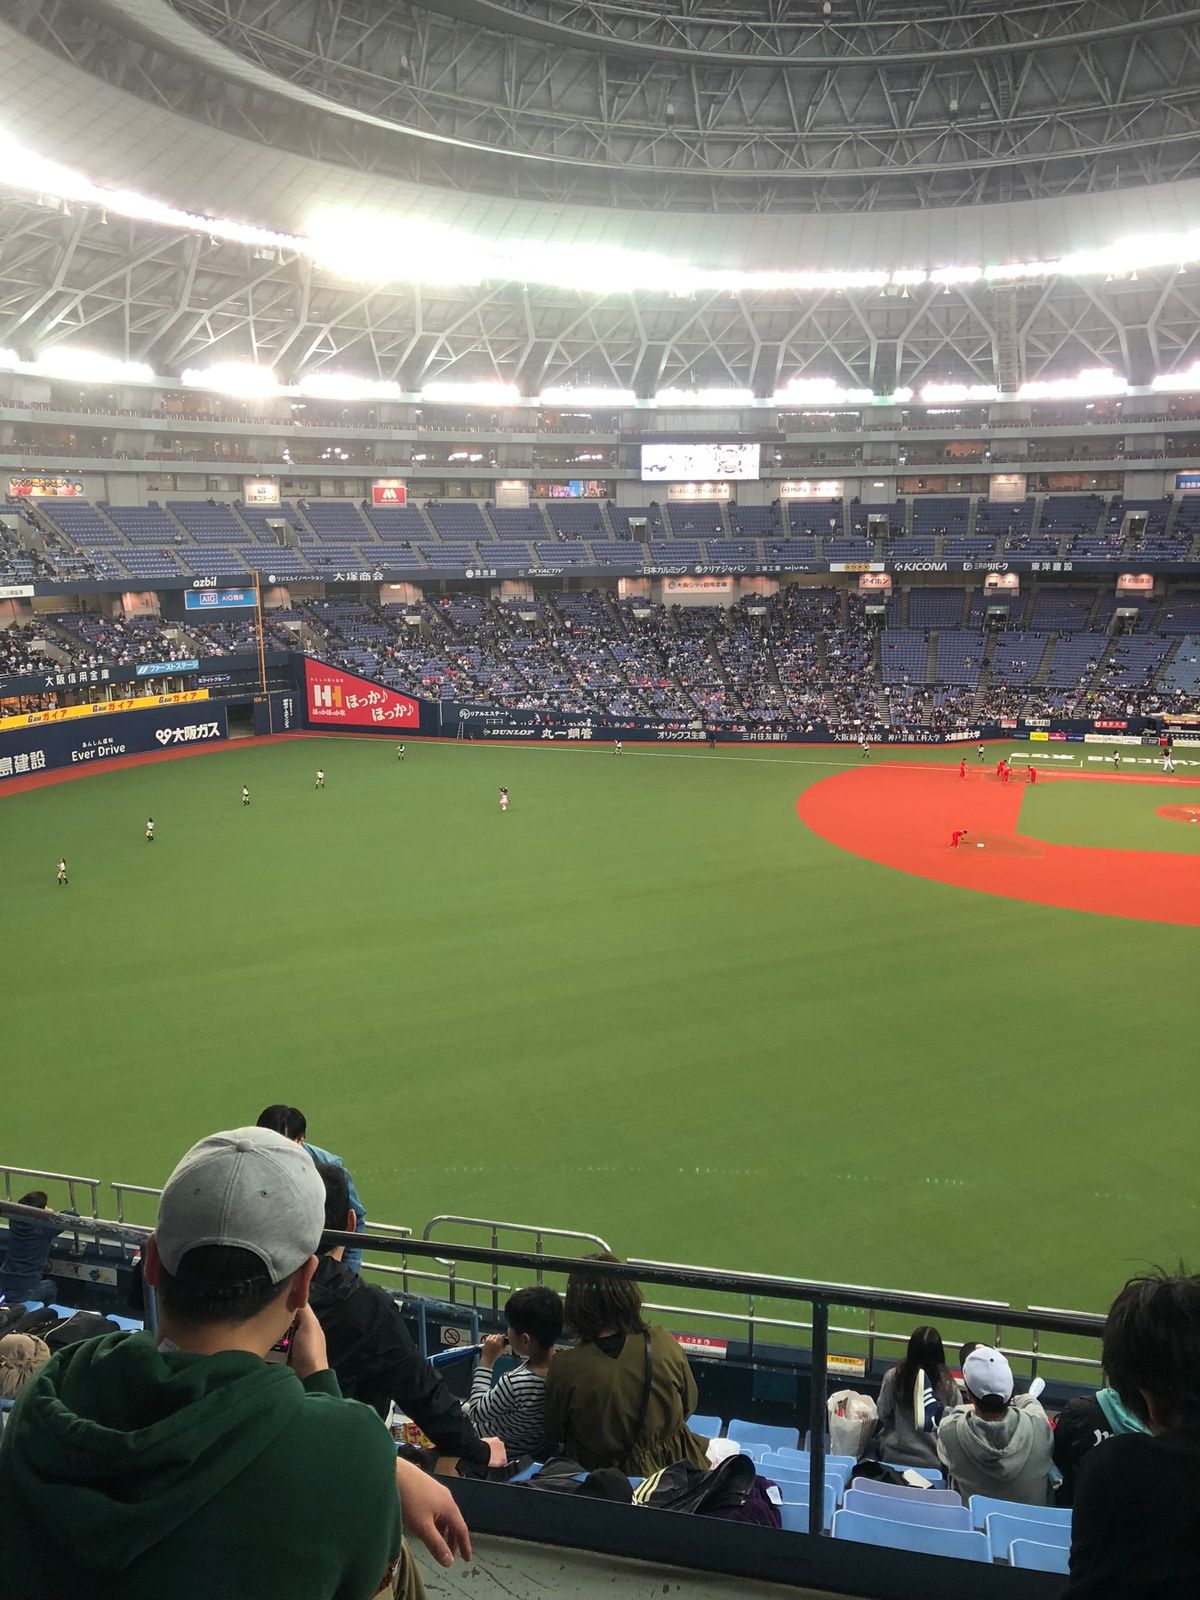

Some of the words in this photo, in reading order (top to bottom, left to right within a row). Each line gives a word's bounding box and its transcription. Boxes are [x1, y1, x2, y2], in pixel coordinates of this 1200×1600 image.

[904, 562, 947, 570] KICONA
[1031, 562, 1073, 571] 東洋建設
[193, 577, 217, 587] azbil
[333, 572, 384, 582] 大塚商会
[150, 662, 198, 671] ファーストステージ
[45, 669, 110, 688] 大阪信用金庫
[173, 692, 197, 702] ガイア
[346, 690, 381, 709] ほっか
[108, 700, 134, 711] ガイア
[42, 709, 68, 721] ガイア
[372, 703, 407, 722] ほっか
[172, 724, 221, 746] 大阪ガス
[541, 728, 593, 740] 丸一鋼管
[657, 731, 707, 740] オリックス生命
[742, 732, 788, 741] 三井住友銀行
[888, 733, 940, 742] 神戸芸術工科大学
[71, 750, 96, 762] Ever
[97, 744, 126, 757] Drive
